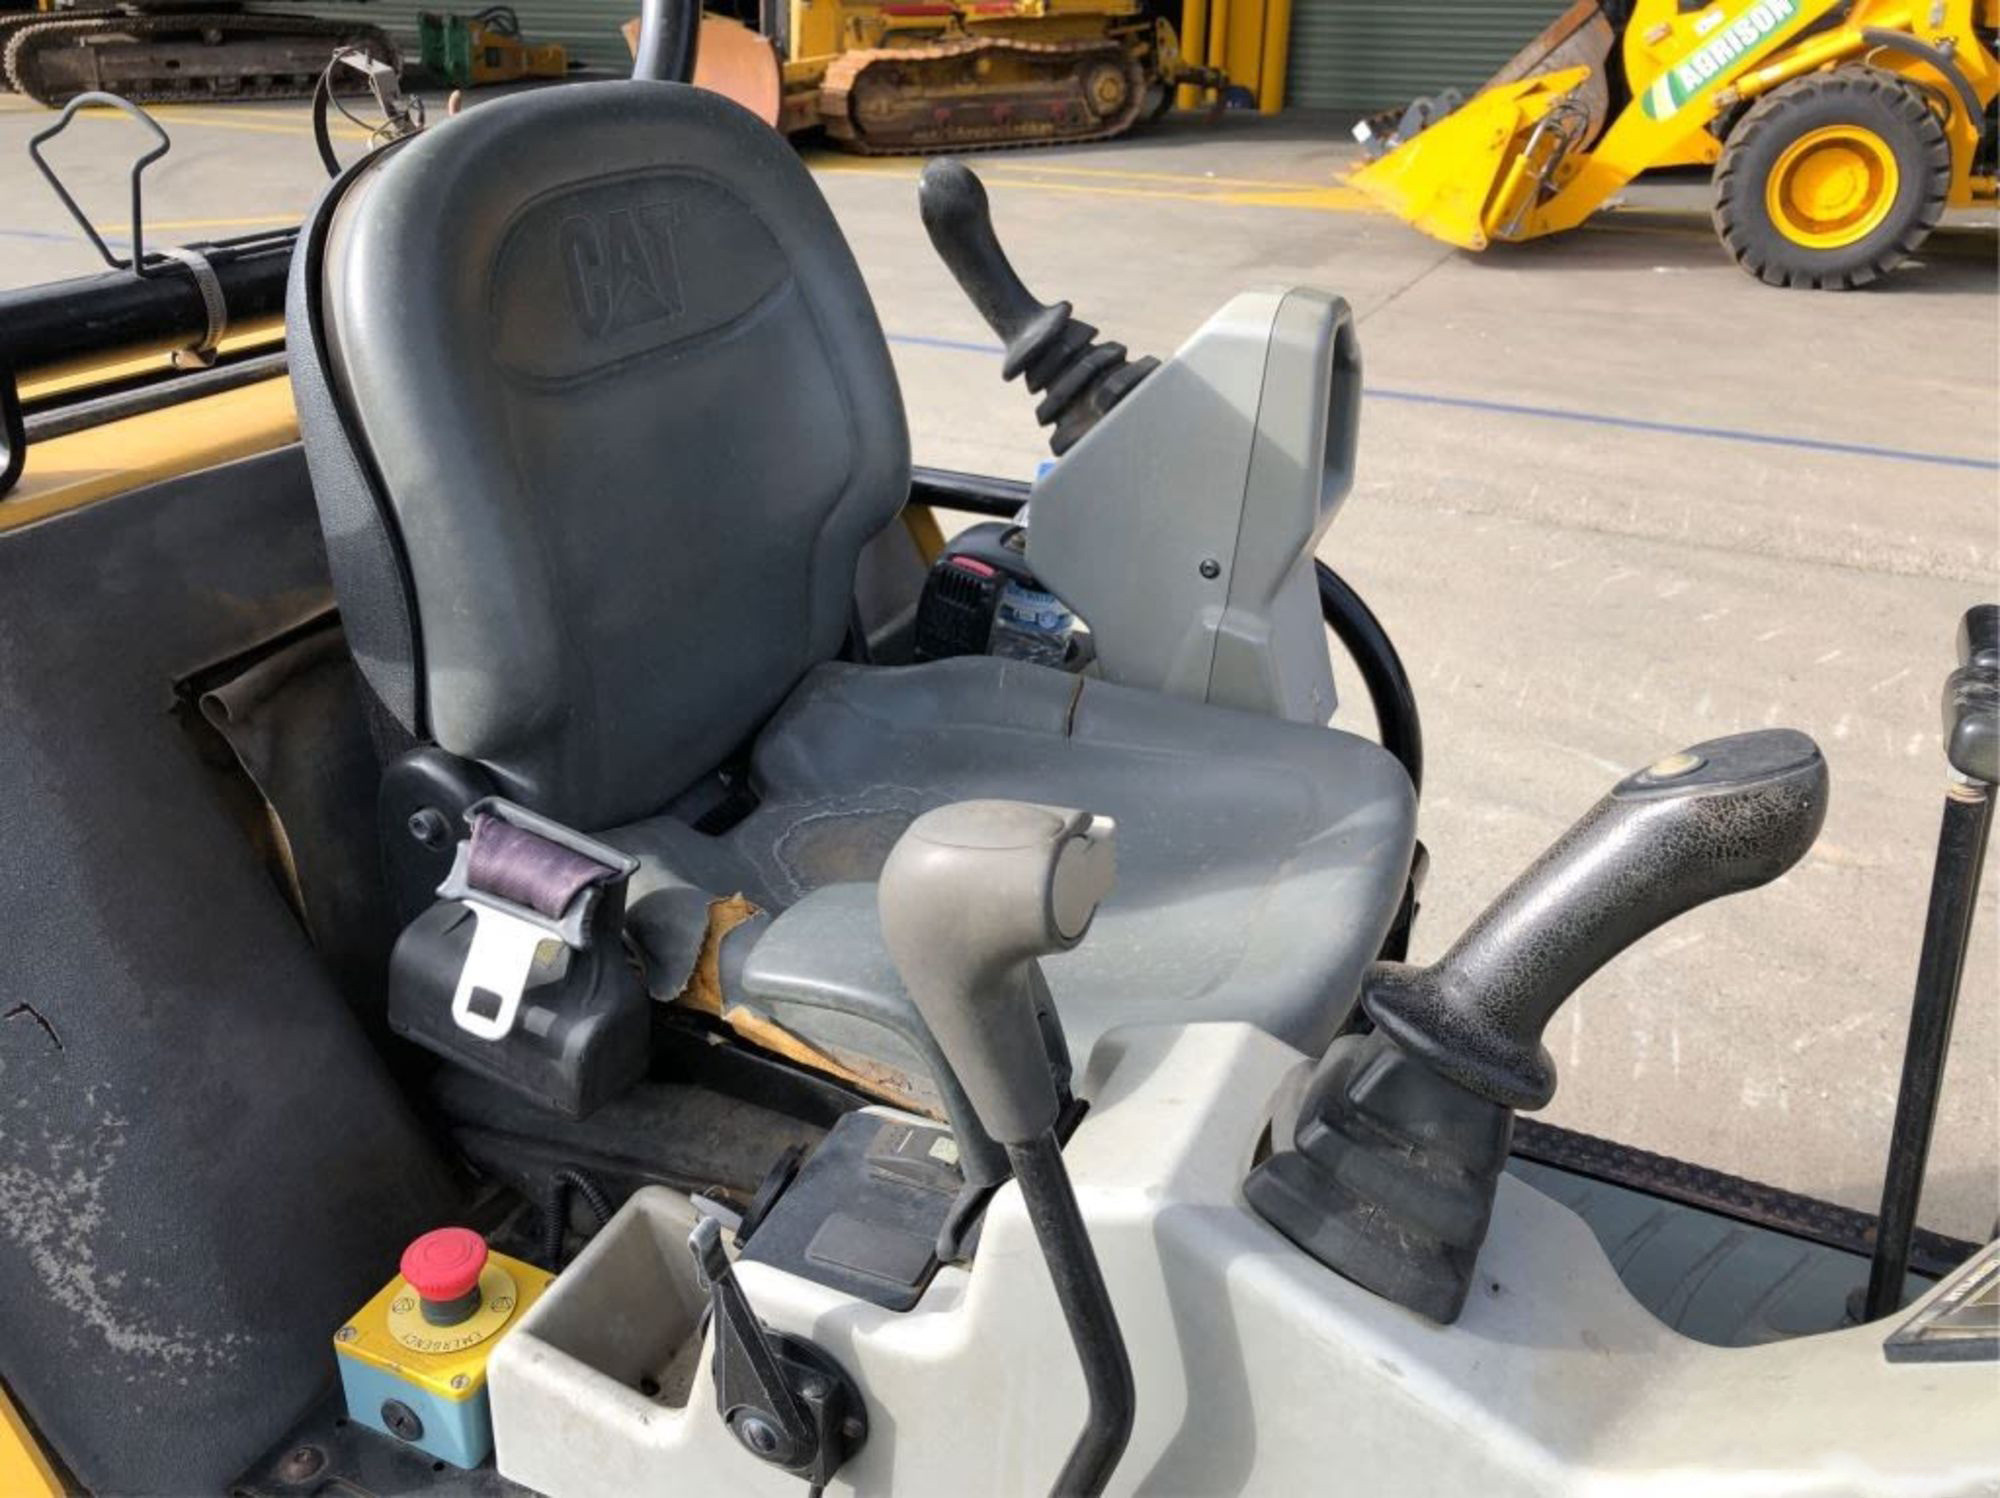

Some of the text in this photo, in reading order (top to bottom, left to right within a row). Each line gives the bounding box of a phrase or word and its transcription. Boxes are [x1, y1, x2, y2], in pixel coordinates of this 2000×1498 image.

[1678, 0, 1795, 93] AGRISON
[558, 200, 688, 337] CAT
[402, 1332, 483, 1351] EMERGENCY
